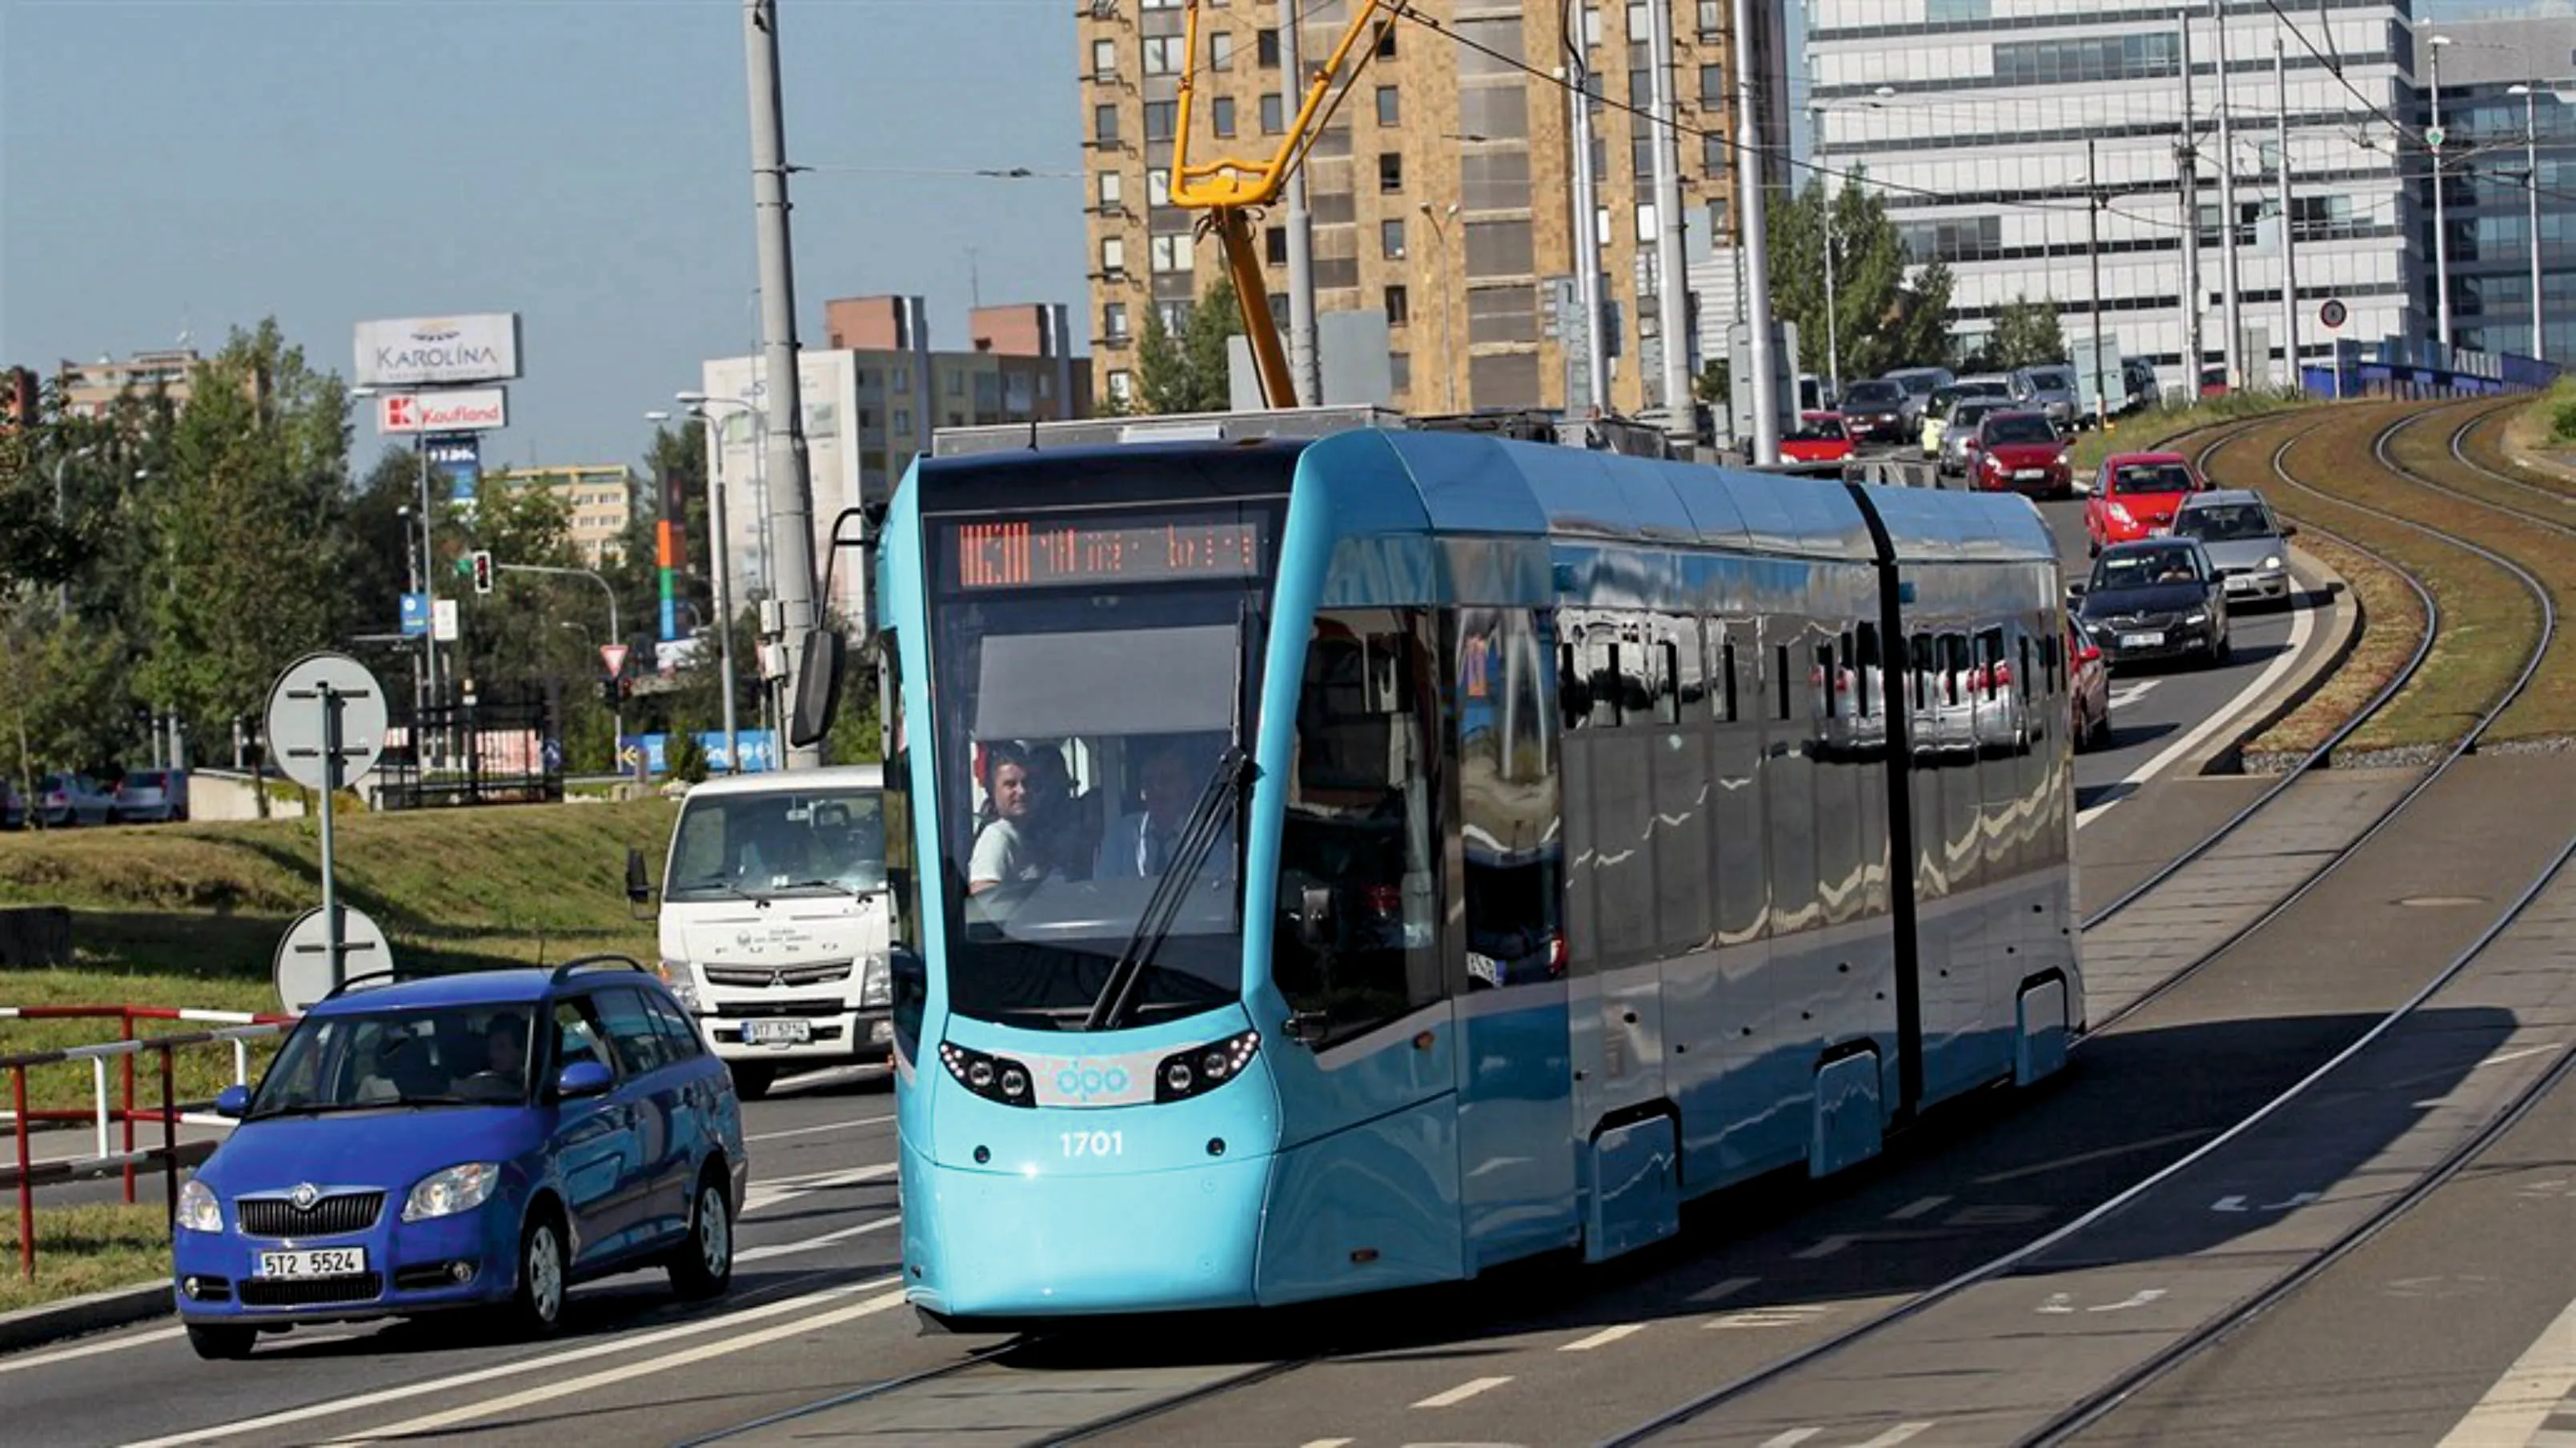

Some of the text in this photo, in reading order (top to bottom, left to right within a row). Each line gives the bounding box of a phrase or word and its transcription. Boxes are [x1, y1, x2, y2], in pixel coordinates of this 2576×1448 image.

[423, 402, 499, 424] Kaufland
[1059, 1130, 1122, 1158] 1701
[265, 1251, 355, 1276] 5T2 5524
